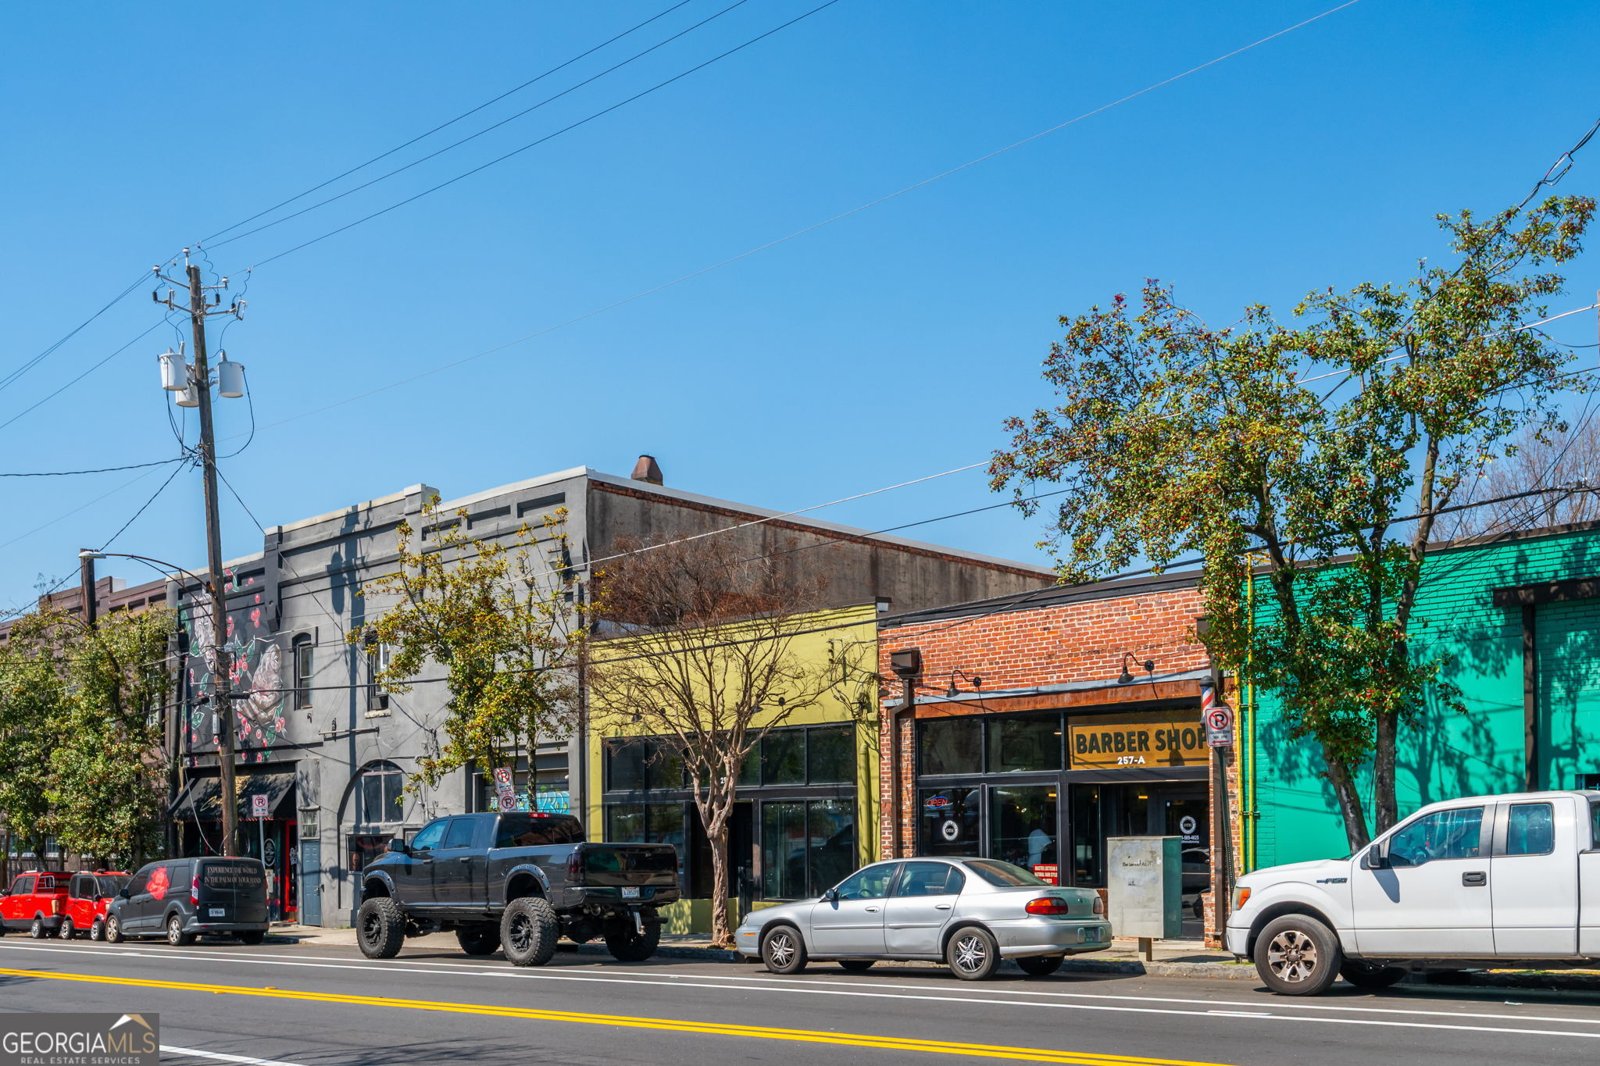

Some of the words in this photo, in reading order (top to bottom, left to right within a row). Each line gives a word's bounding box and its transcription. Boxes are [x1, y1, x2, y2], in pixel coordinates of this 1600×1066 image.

[1076, 731, 1150, 754] BARBER
[1155, 727, 1207, 752] SHOP
[1117, 756, 1146, 765] 257-A
[927, 798, 947, 806] OPEN
